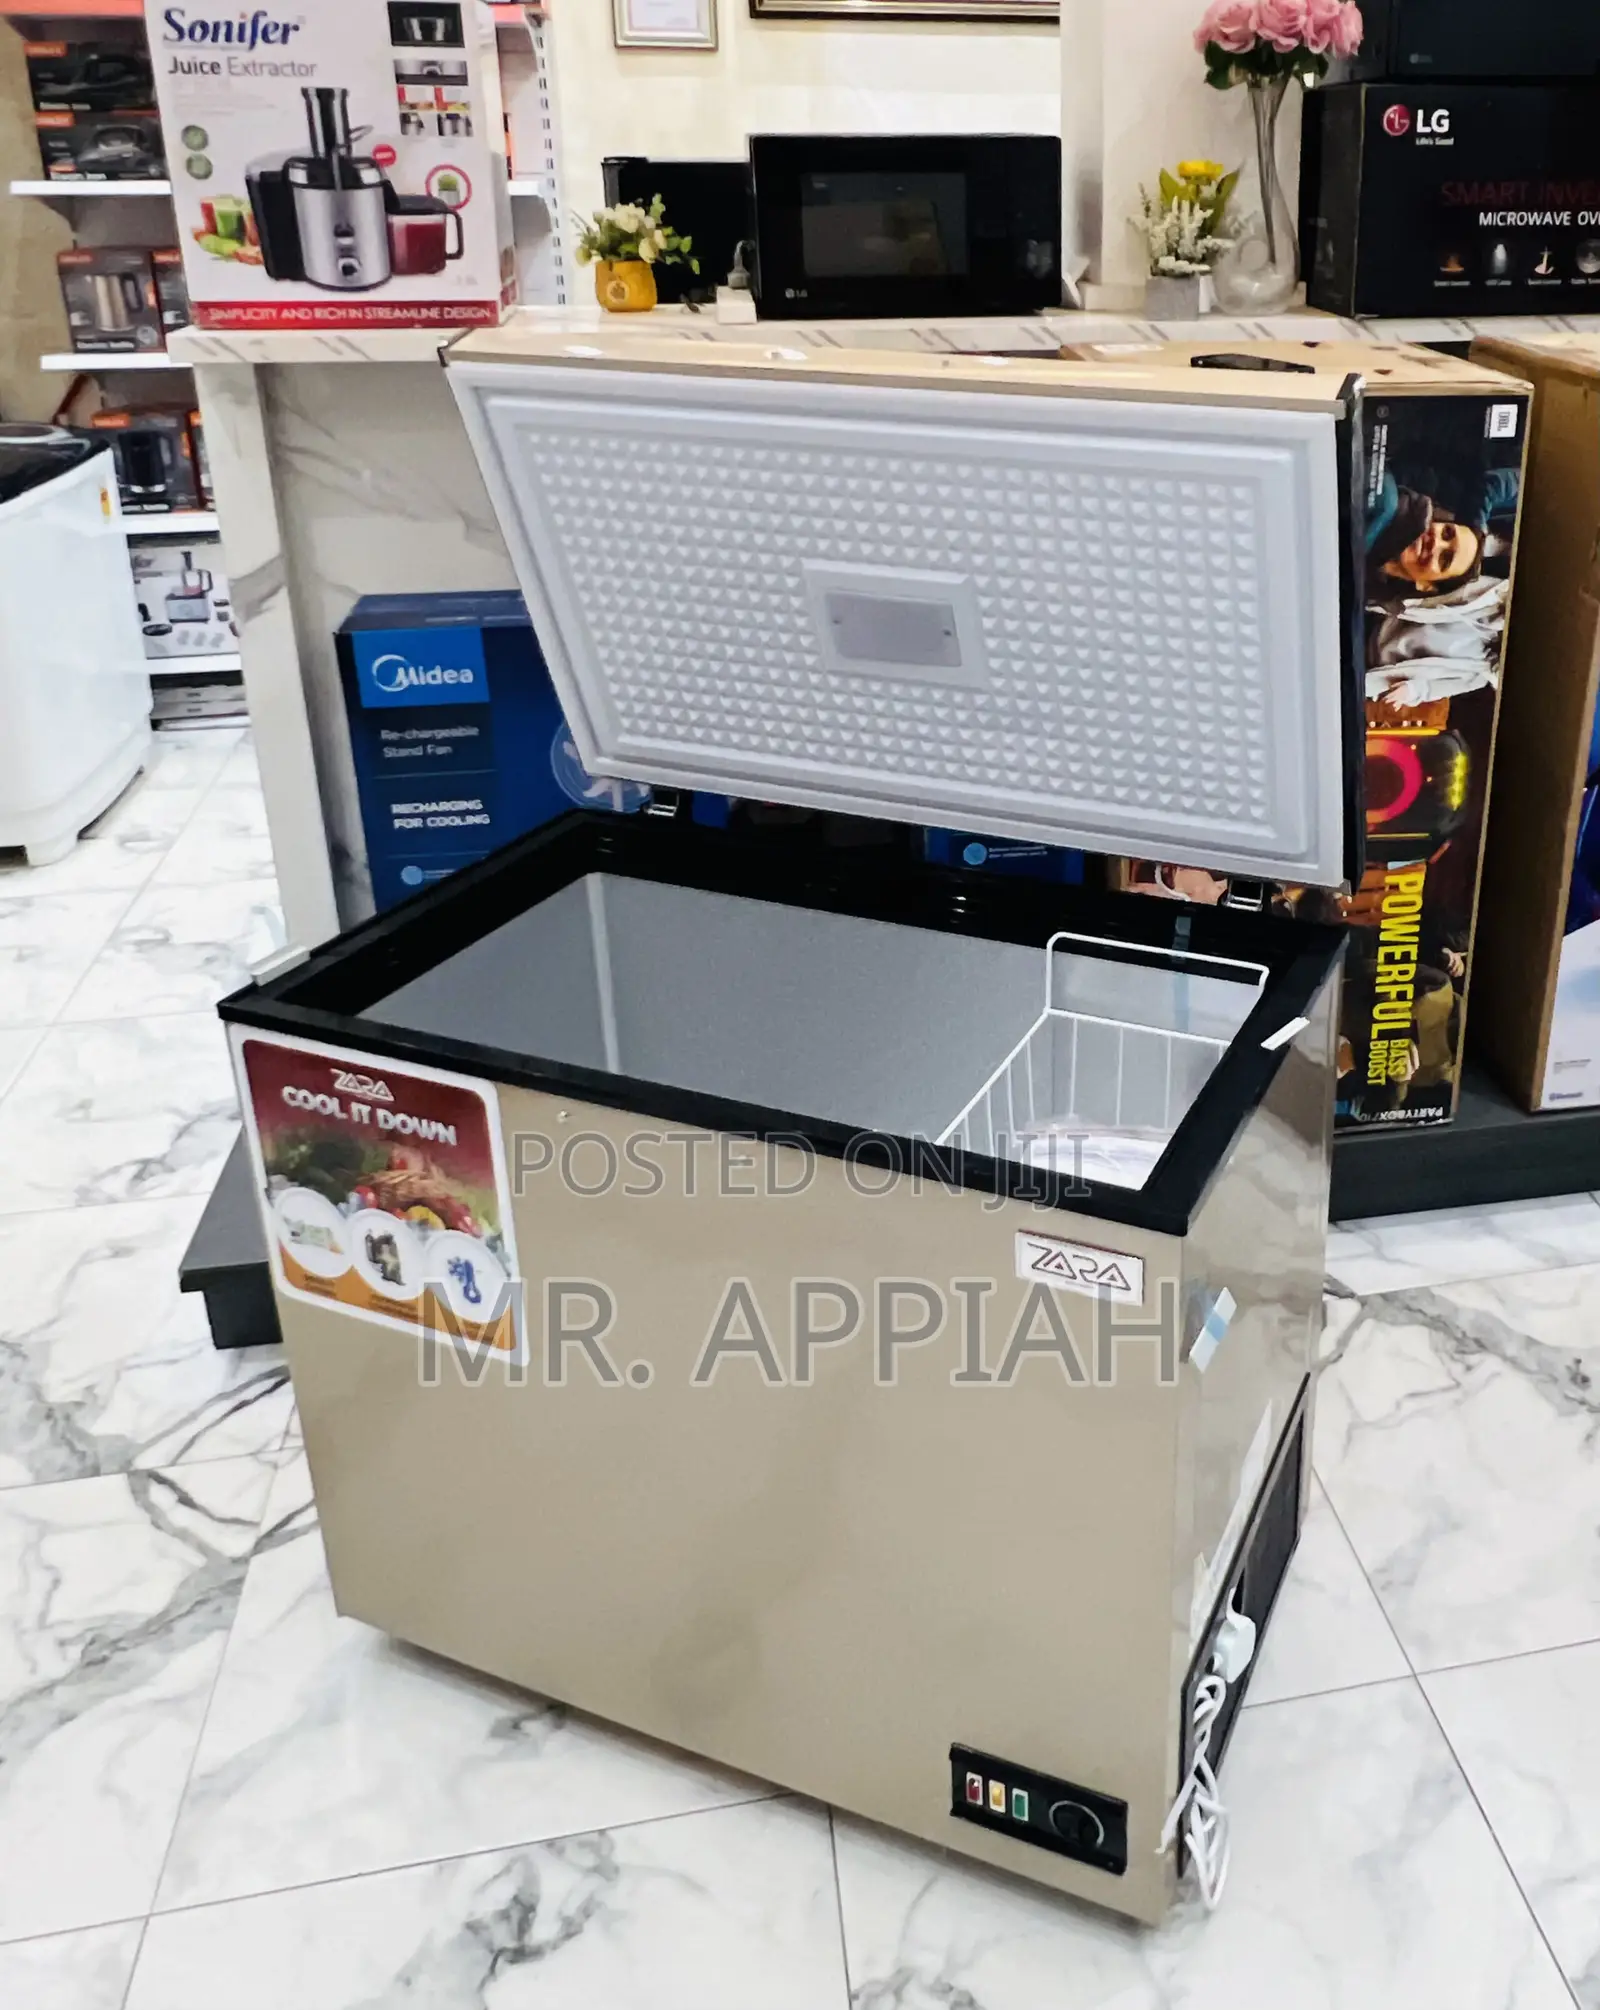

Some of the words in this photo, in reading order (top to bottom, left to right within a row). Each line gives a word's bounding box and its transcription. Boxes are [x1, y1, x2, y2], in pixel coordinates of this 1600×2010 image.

[162, 8, 300, 51] Sonifer
[168, 56, 221, 75] Juice
[227, 56, 317, 77] Extractor
[1416, 109, 1450, 133] LG
[1440, 181, 1530, 206] SMART
[1538, 180, 1600, 206] INVE
[1478, 211, 1572, 226] MICROWAVE
[281, 307, 312, 320] AND
[443, 306, 490, 319] DESIGN
[388, 662, 474, 689] Midea
[383, 745, 424, 758] Stand
[426, 744, 452, 756] Fan
[390, 799, 484, 814] RECHARGING
[393, 817, 423, 829] FOR
[427, 814, 491, 828] COOLING
[1370, 871, 1427, 1040] POWERFUL
[1367, 1040, 1389, 1086] BOOST
[1387, 1039, 1411, 1077] BASS
[330, 1068, 395, 1101] ZARA
[282, 1086, 348, 1119] COOL
[350, 1101, 372, 1124] IT
[376, 1108, 457, 1146] DOWN
[1027, 1242, 1131, 1291] ZARA
